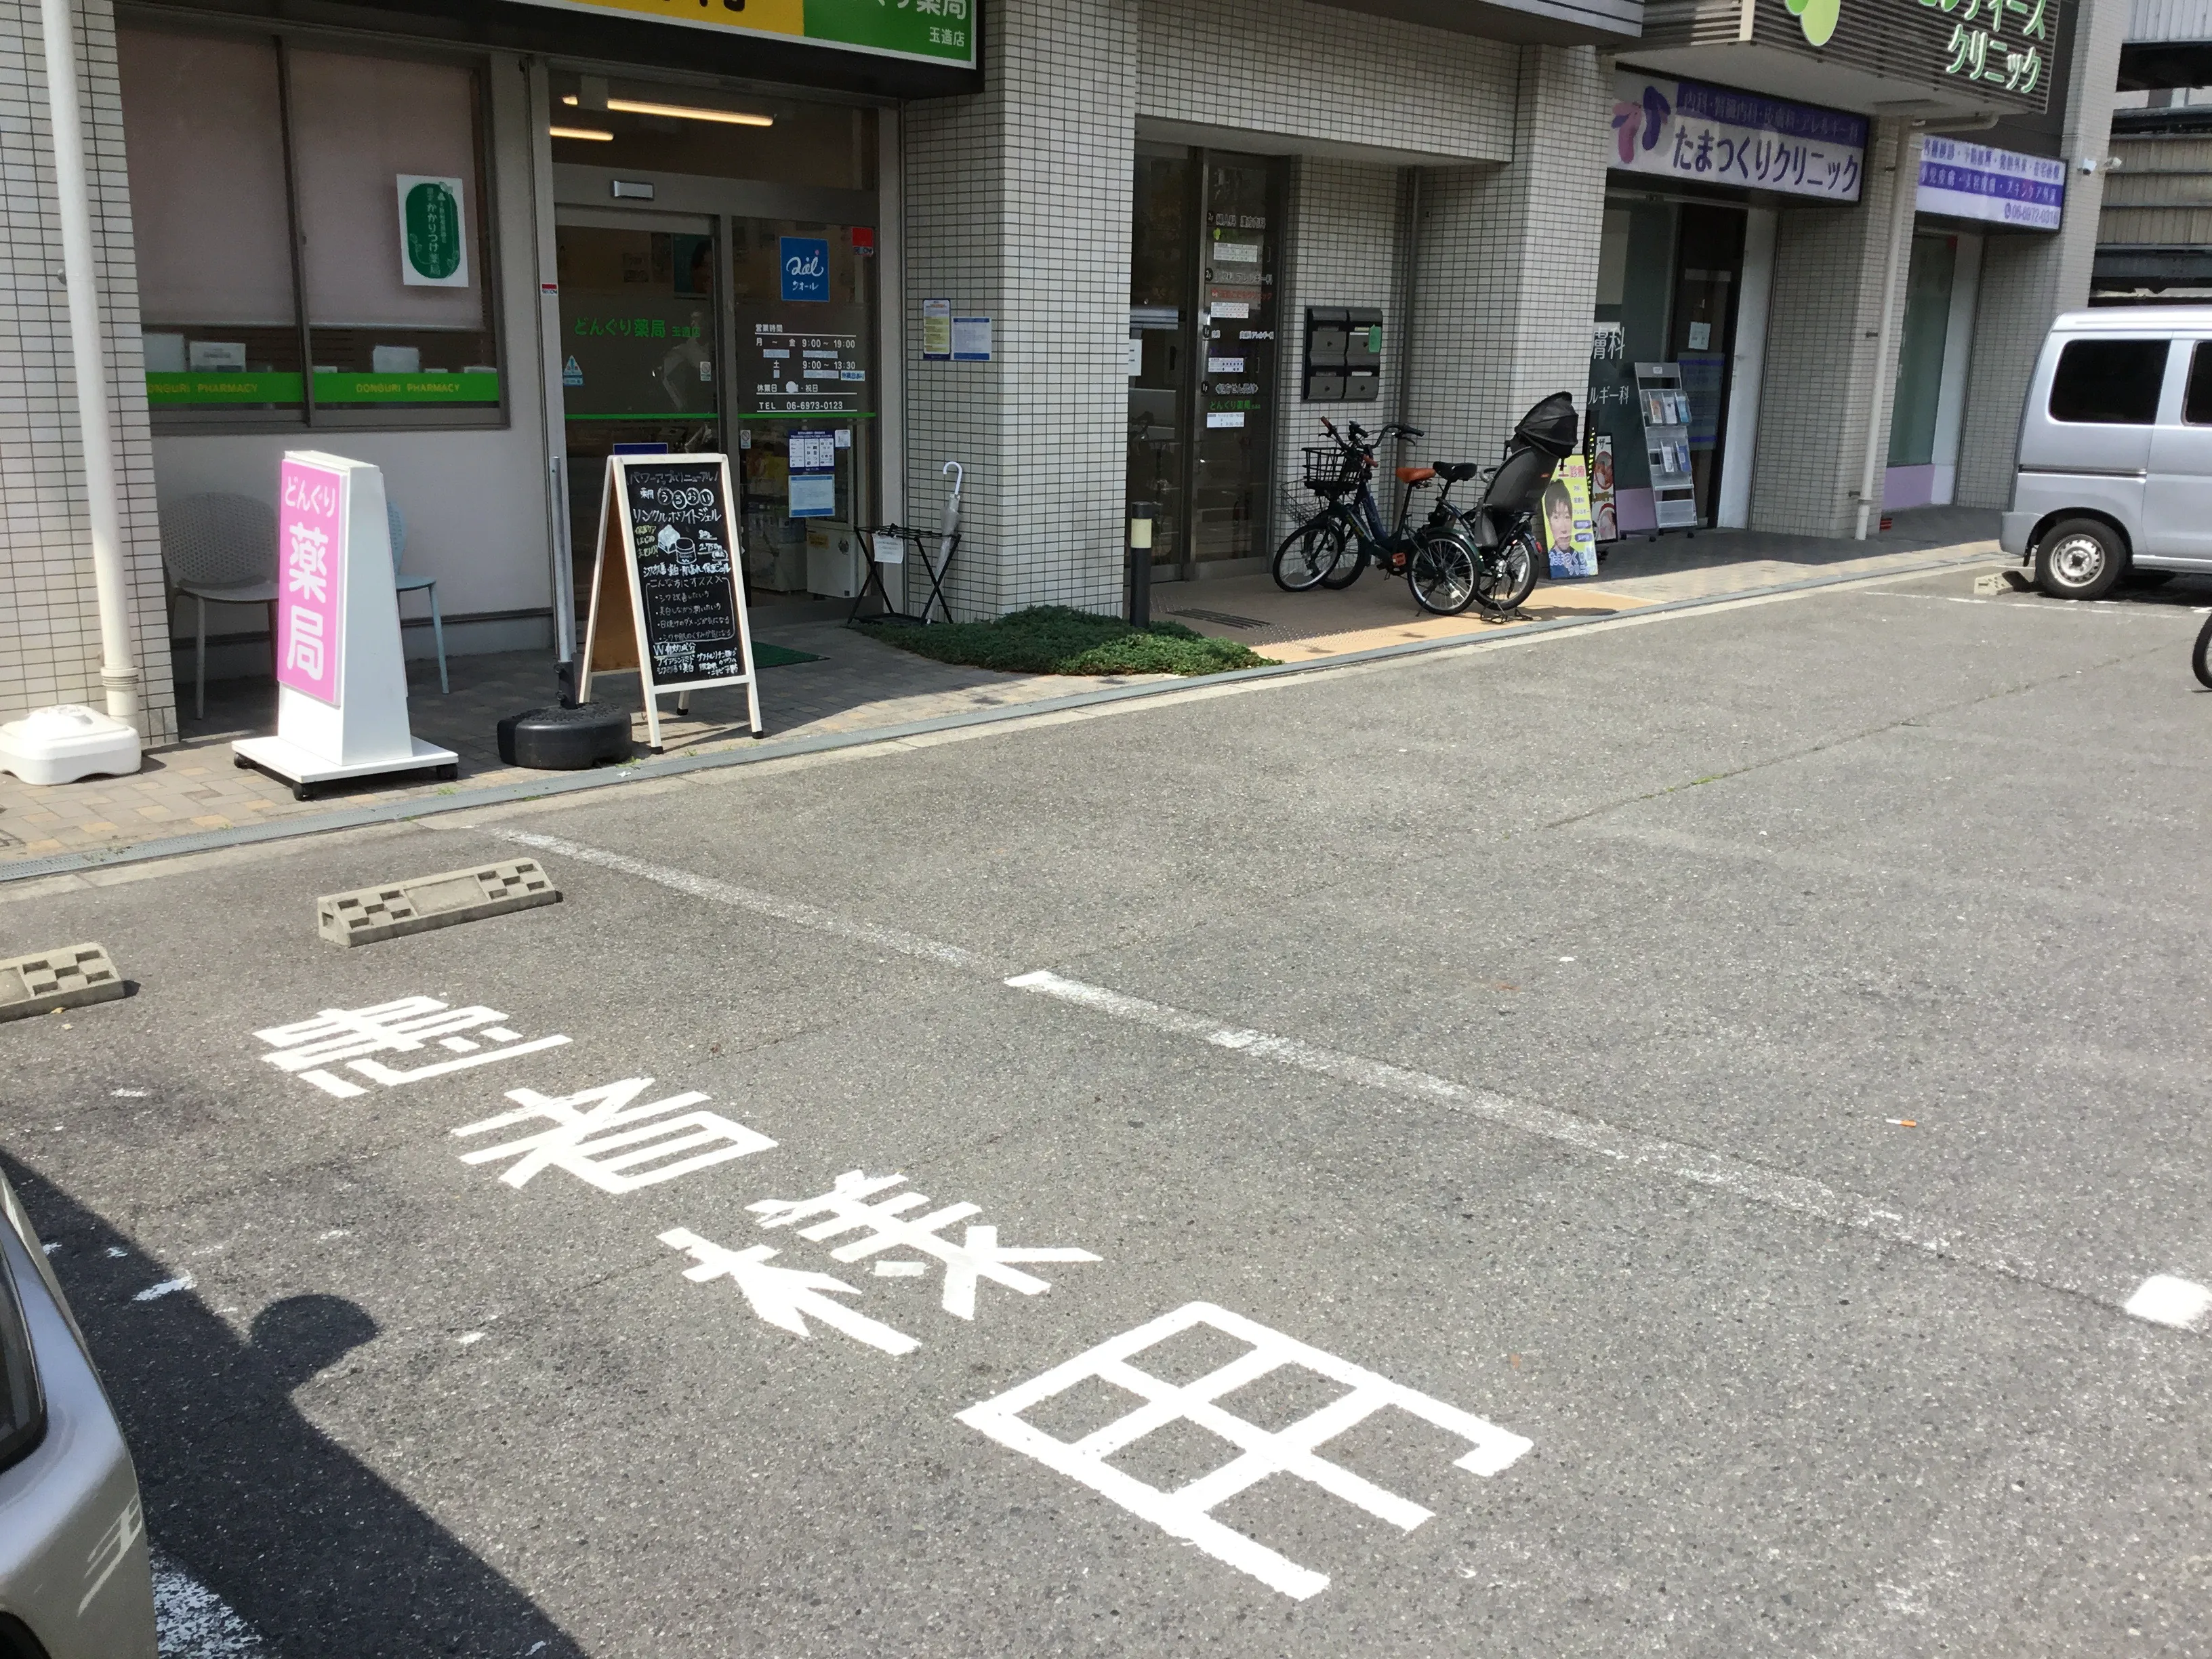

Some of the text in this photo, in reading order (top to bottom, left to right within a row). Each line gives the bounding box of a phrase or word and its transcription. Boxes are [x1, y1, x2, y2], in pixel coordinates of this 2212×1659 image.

[929, 26, 964, 47] 玉造店
[1946, 24, 2041, 94] クリニック
[1673, 124, 1858, 193] たまつくりクリニック
[575, 317, 701, 338] どんぐり薬局 玉造店
[755, 323, 783, 333] 営業時間
[756, 337, 762, 346] 月
[789, 338, 796, 347] 金
[802, 339, 821, 348] 9:00
[834, 340, 855, 348] 19:00
[1593, 326, 1626, 360] 膚科
[773, 360, 779, 369] 土
[802, 361, 821, 369] 9:00
[834, 361, 856, 369] 13:30
[197, 384, 258, 393] PHARMACY
[356, 384, 460, 392] DONGURI PHARMACY
[757, 384, 777, 392] 休業日
[1588, 386, 1629, 405] ルギー科
[759, 401, 843, 410] TEL 06-6973-0123
[284, 476, 336, 518] どんぐり
[632, 506, 722, 525] リンクルホワイトジェル
[287, 521, 329, 681] 薬局
